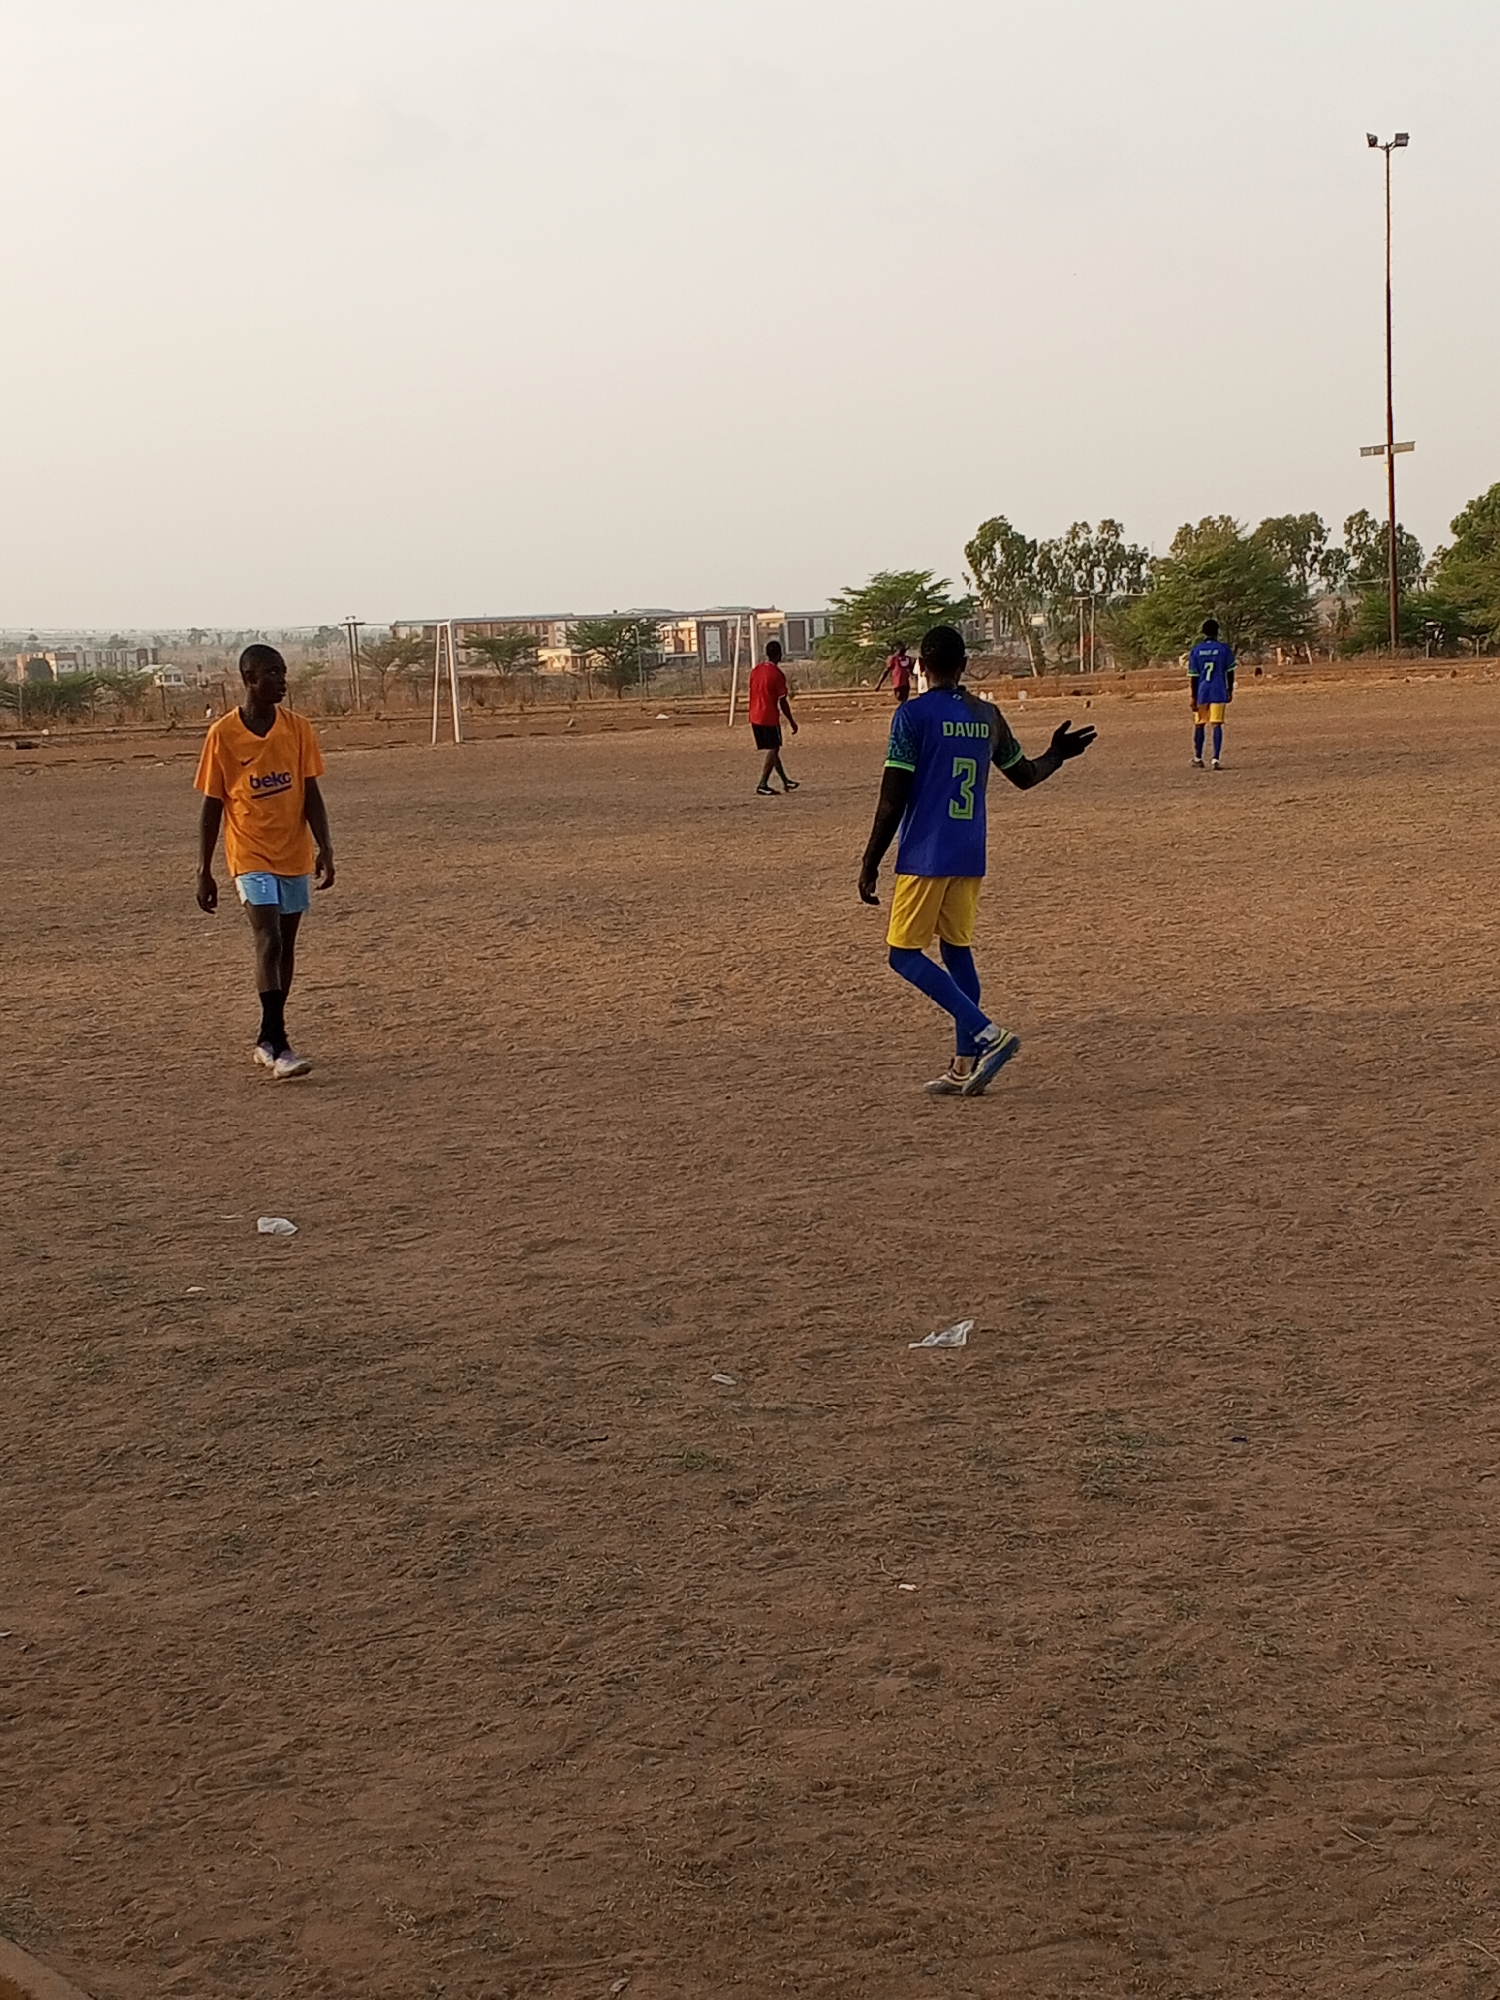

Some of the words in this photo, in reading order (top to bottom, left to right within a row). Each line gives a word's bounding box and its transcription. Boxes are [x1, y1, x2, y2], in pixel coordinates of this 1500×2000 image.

[1204, 662, 1214, 681] 7
[942, 721, 990, 739] DAVID
[249, 771, 292, 790] beko
[949, 757, 977, 820] 3
